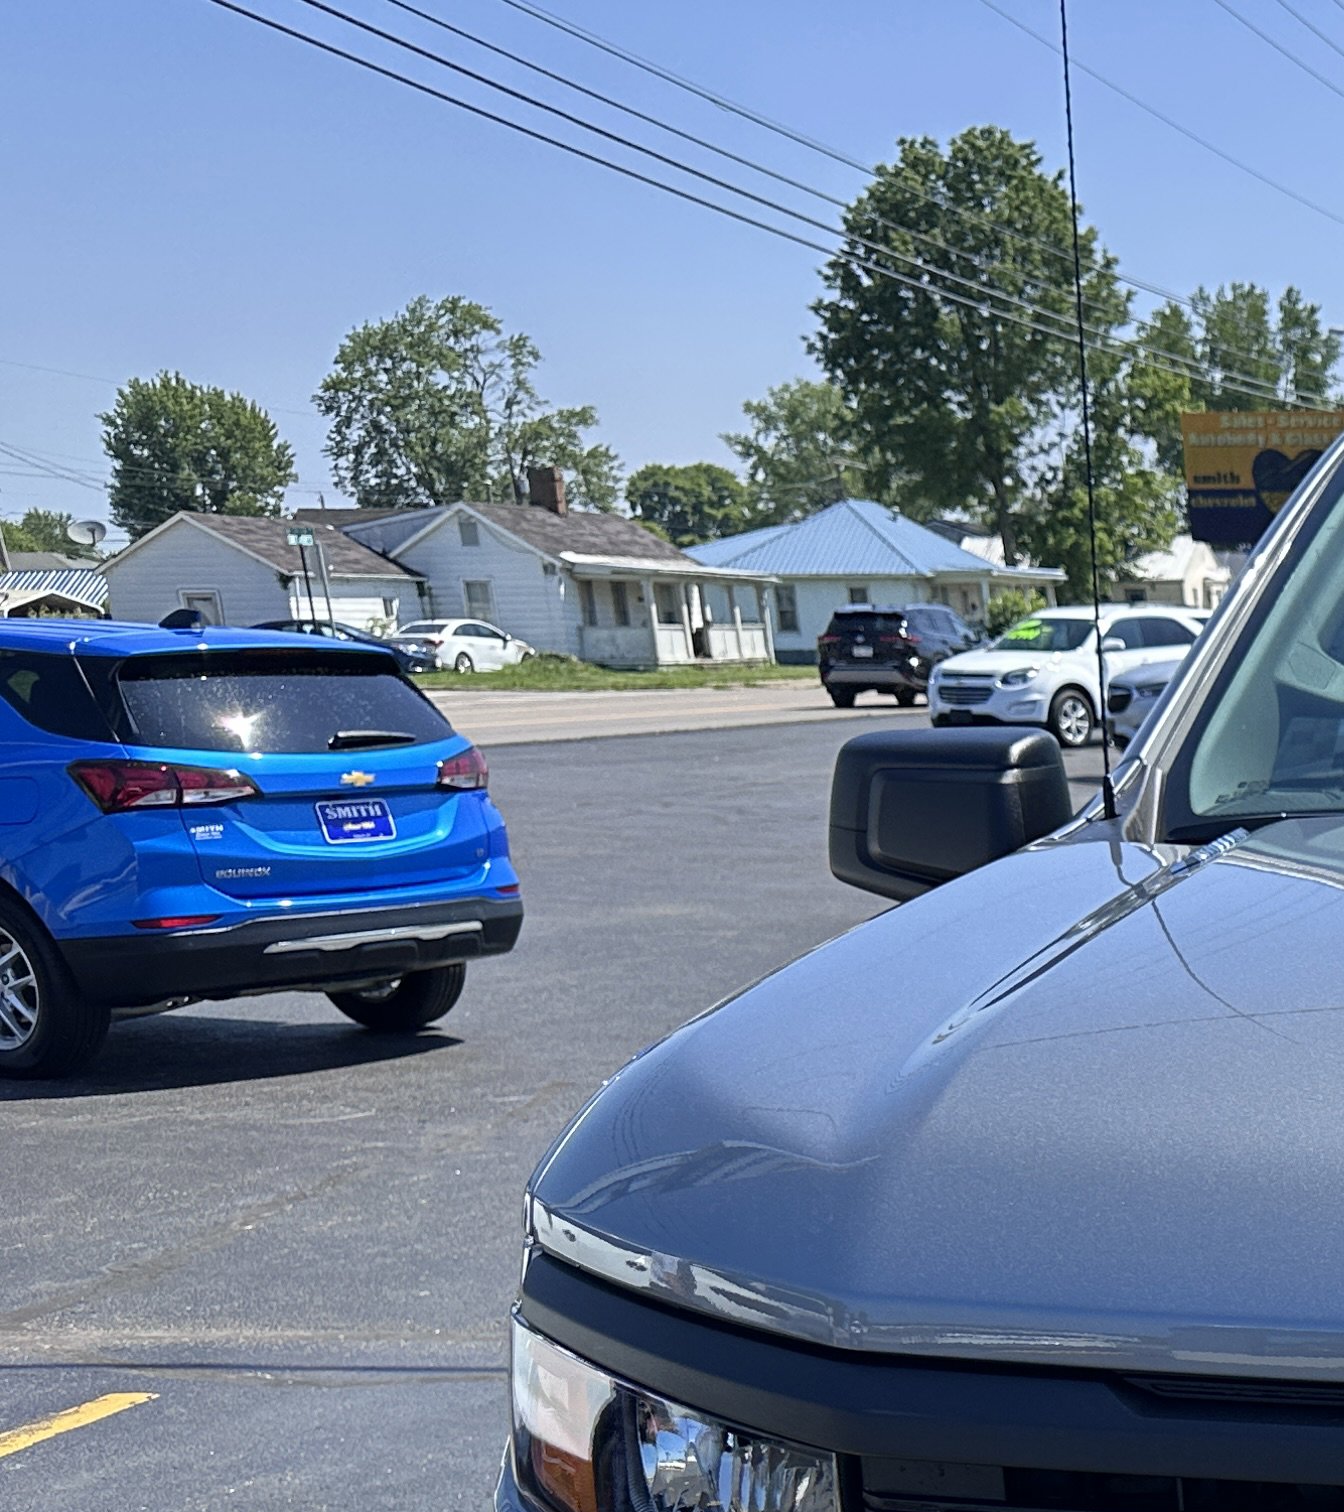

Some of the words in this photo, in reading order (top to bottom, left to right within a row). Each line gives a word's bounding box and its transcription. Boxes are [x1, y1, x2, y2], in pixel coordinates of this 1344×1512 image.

[1193, 471, 1240, 484] smith
[325, 804, 382, 820] SMITH
[215, 866, 271, 879] EQUINOX
